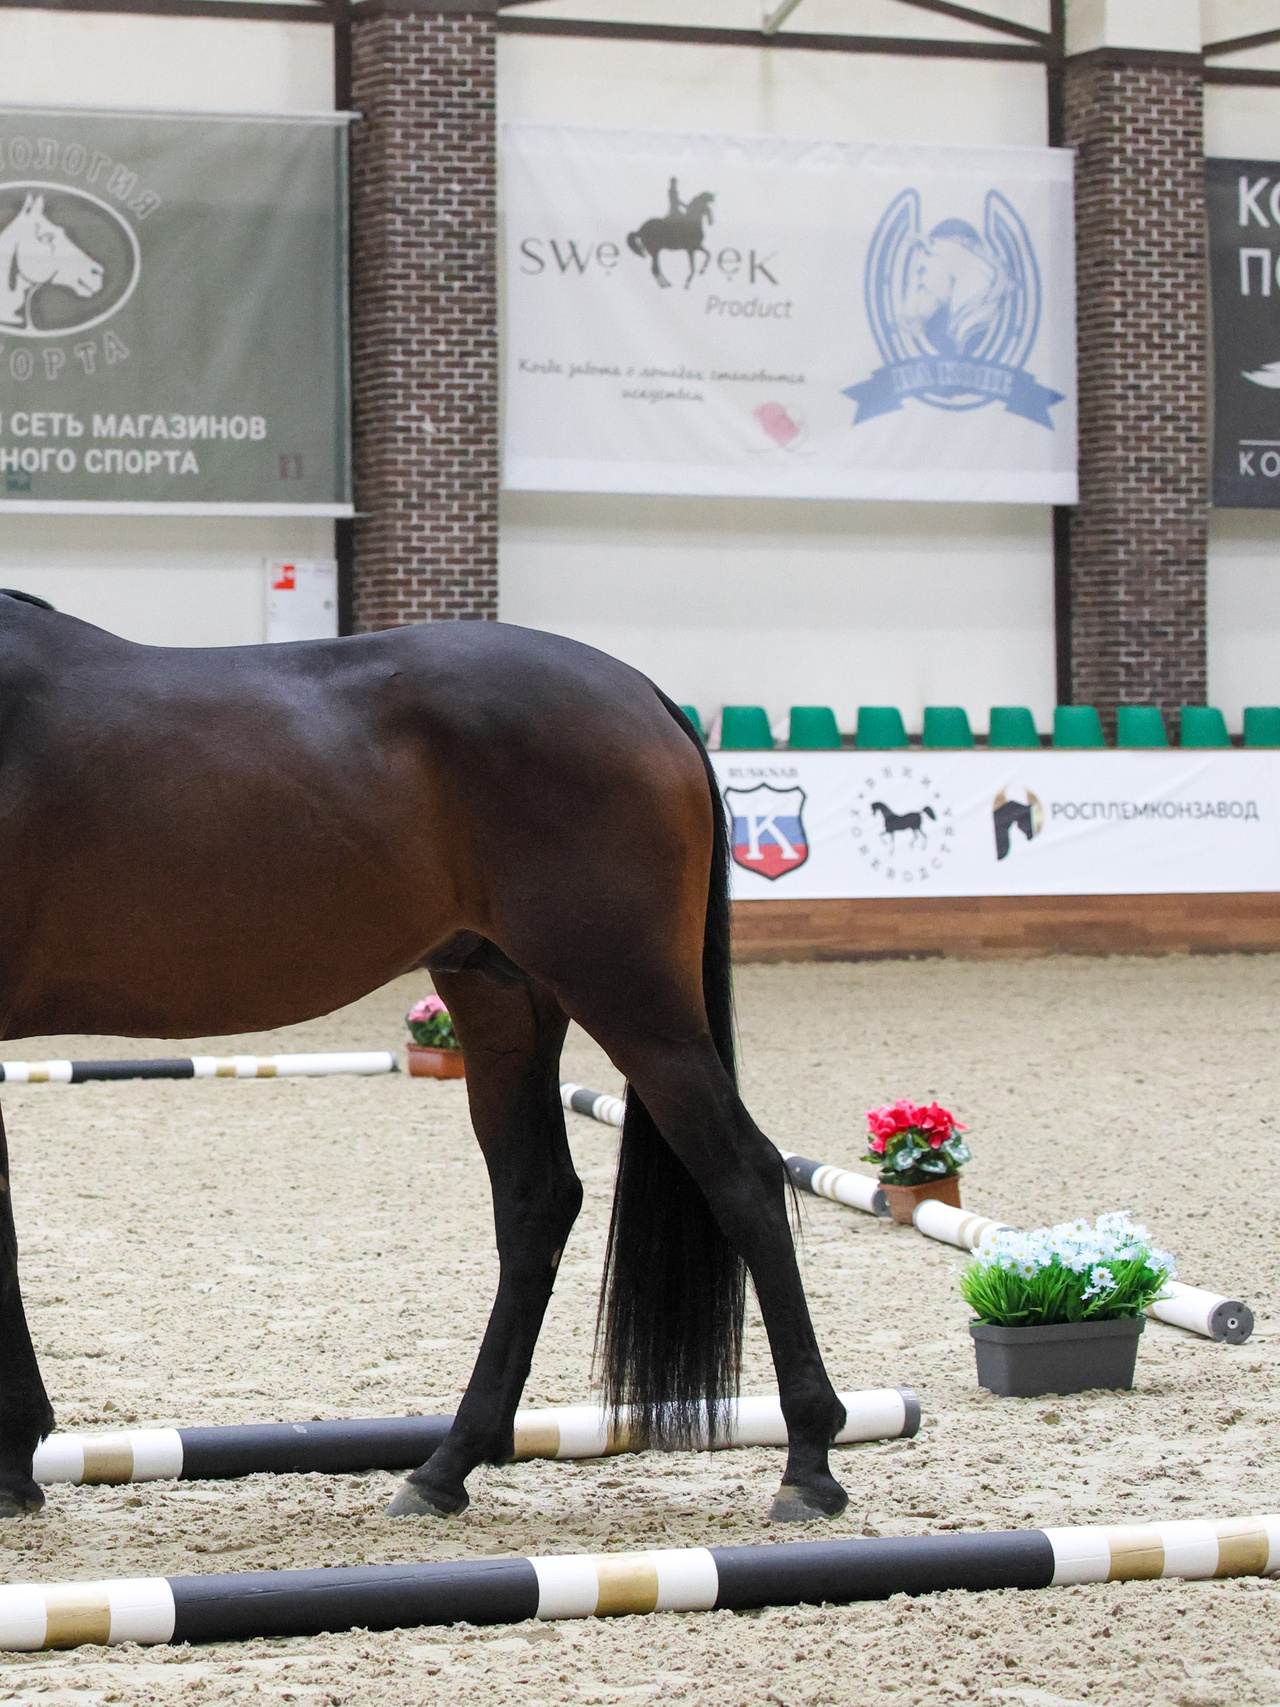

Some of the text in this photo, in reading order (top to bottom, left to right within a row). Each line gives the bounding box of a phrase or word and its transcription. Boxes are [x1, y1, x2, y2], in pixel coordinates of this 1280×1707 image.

[705, 294, 794, 320] Product
[10, 411, 84, 438] СЕТЬ
[92, 413, 267, 440] МАГАЗИНОВ
[84, 449, 200, 475] СПОРТА
[1051, 801, 1260, 822] РОСПЛЕМКОНЗАВОД
